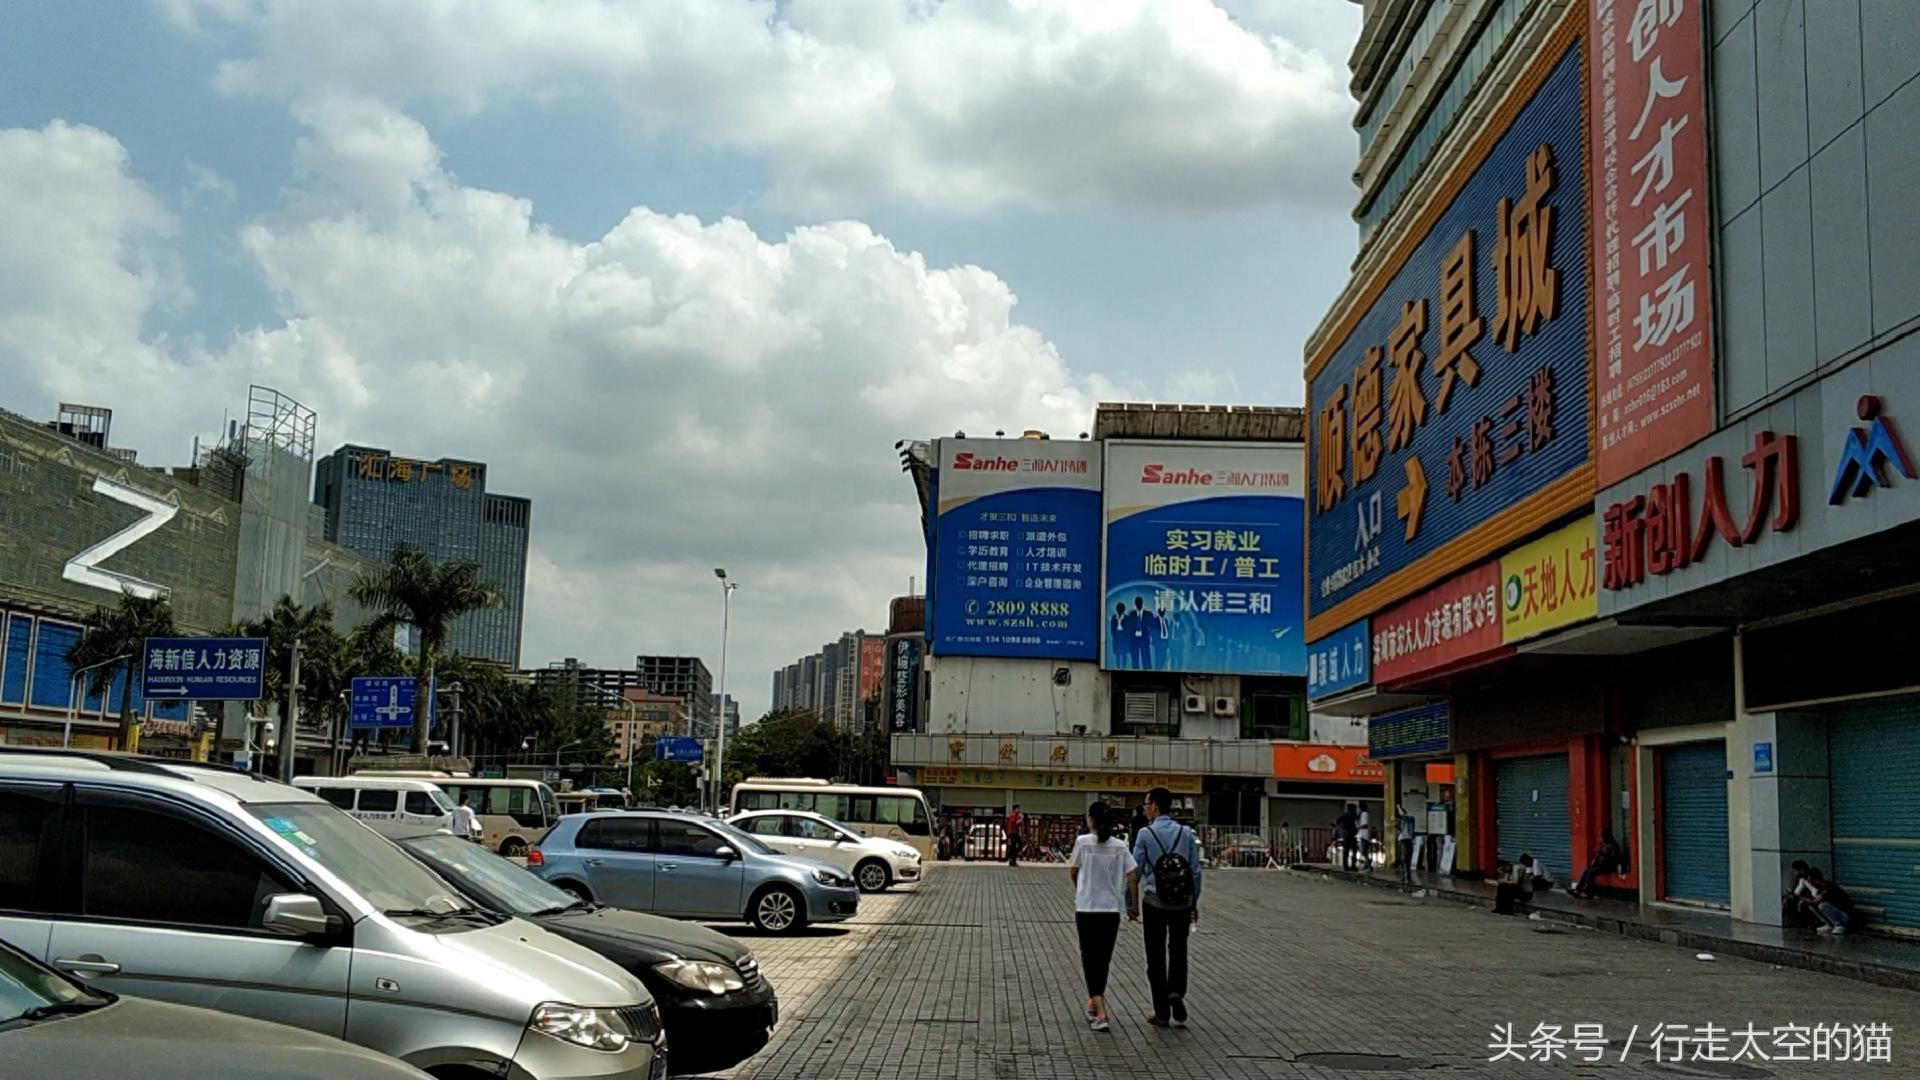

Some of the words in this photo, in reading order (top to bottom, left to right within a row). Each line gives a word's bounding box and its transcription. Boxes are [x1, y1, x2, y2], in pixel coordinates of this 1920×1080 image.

[1316, 143, 1560, 516] 顺德家具城
[1444, 366, 1553, 500] 本栋三楼
[360, 453, 470, 490] 汇海广场
[953, 453, 1019, 471] Sanhe
[1141, 464, 1213, 486] Sanhe
[1354, 490, 1382, 551] 入口
[1603, 431, 1800, 591] 新创人力
[968, 530, 1009, 541] 招聘求职
[1025, 532, 1067, 542] 派遣外包
[1166, 529, 1261, 551] 实习就业
[967, 545, 1008, 557] 学历教育
[1024, 547, 1067, 558] 人才培训
[967, 561, 1008, 571] 代理招聘
[966, 576, 1008, 587] 深户咨询
[1024, 577, 1082, 589] 企业管理咨询
[1523, 538, 1596, 619] 天地人力
[987, 600, 1025, 615] 2809
[1030, 602, 1070, 617] 8888
[1154, 589, 1271, 614] 请认准三和
[966, 617, 1068, 629] www.szsh.com
[148, 648, 260, 671] 海新信人力资源
[186, 676, 213, 684] HUMAN
[216, 676, 257, 684] RESOURCES
